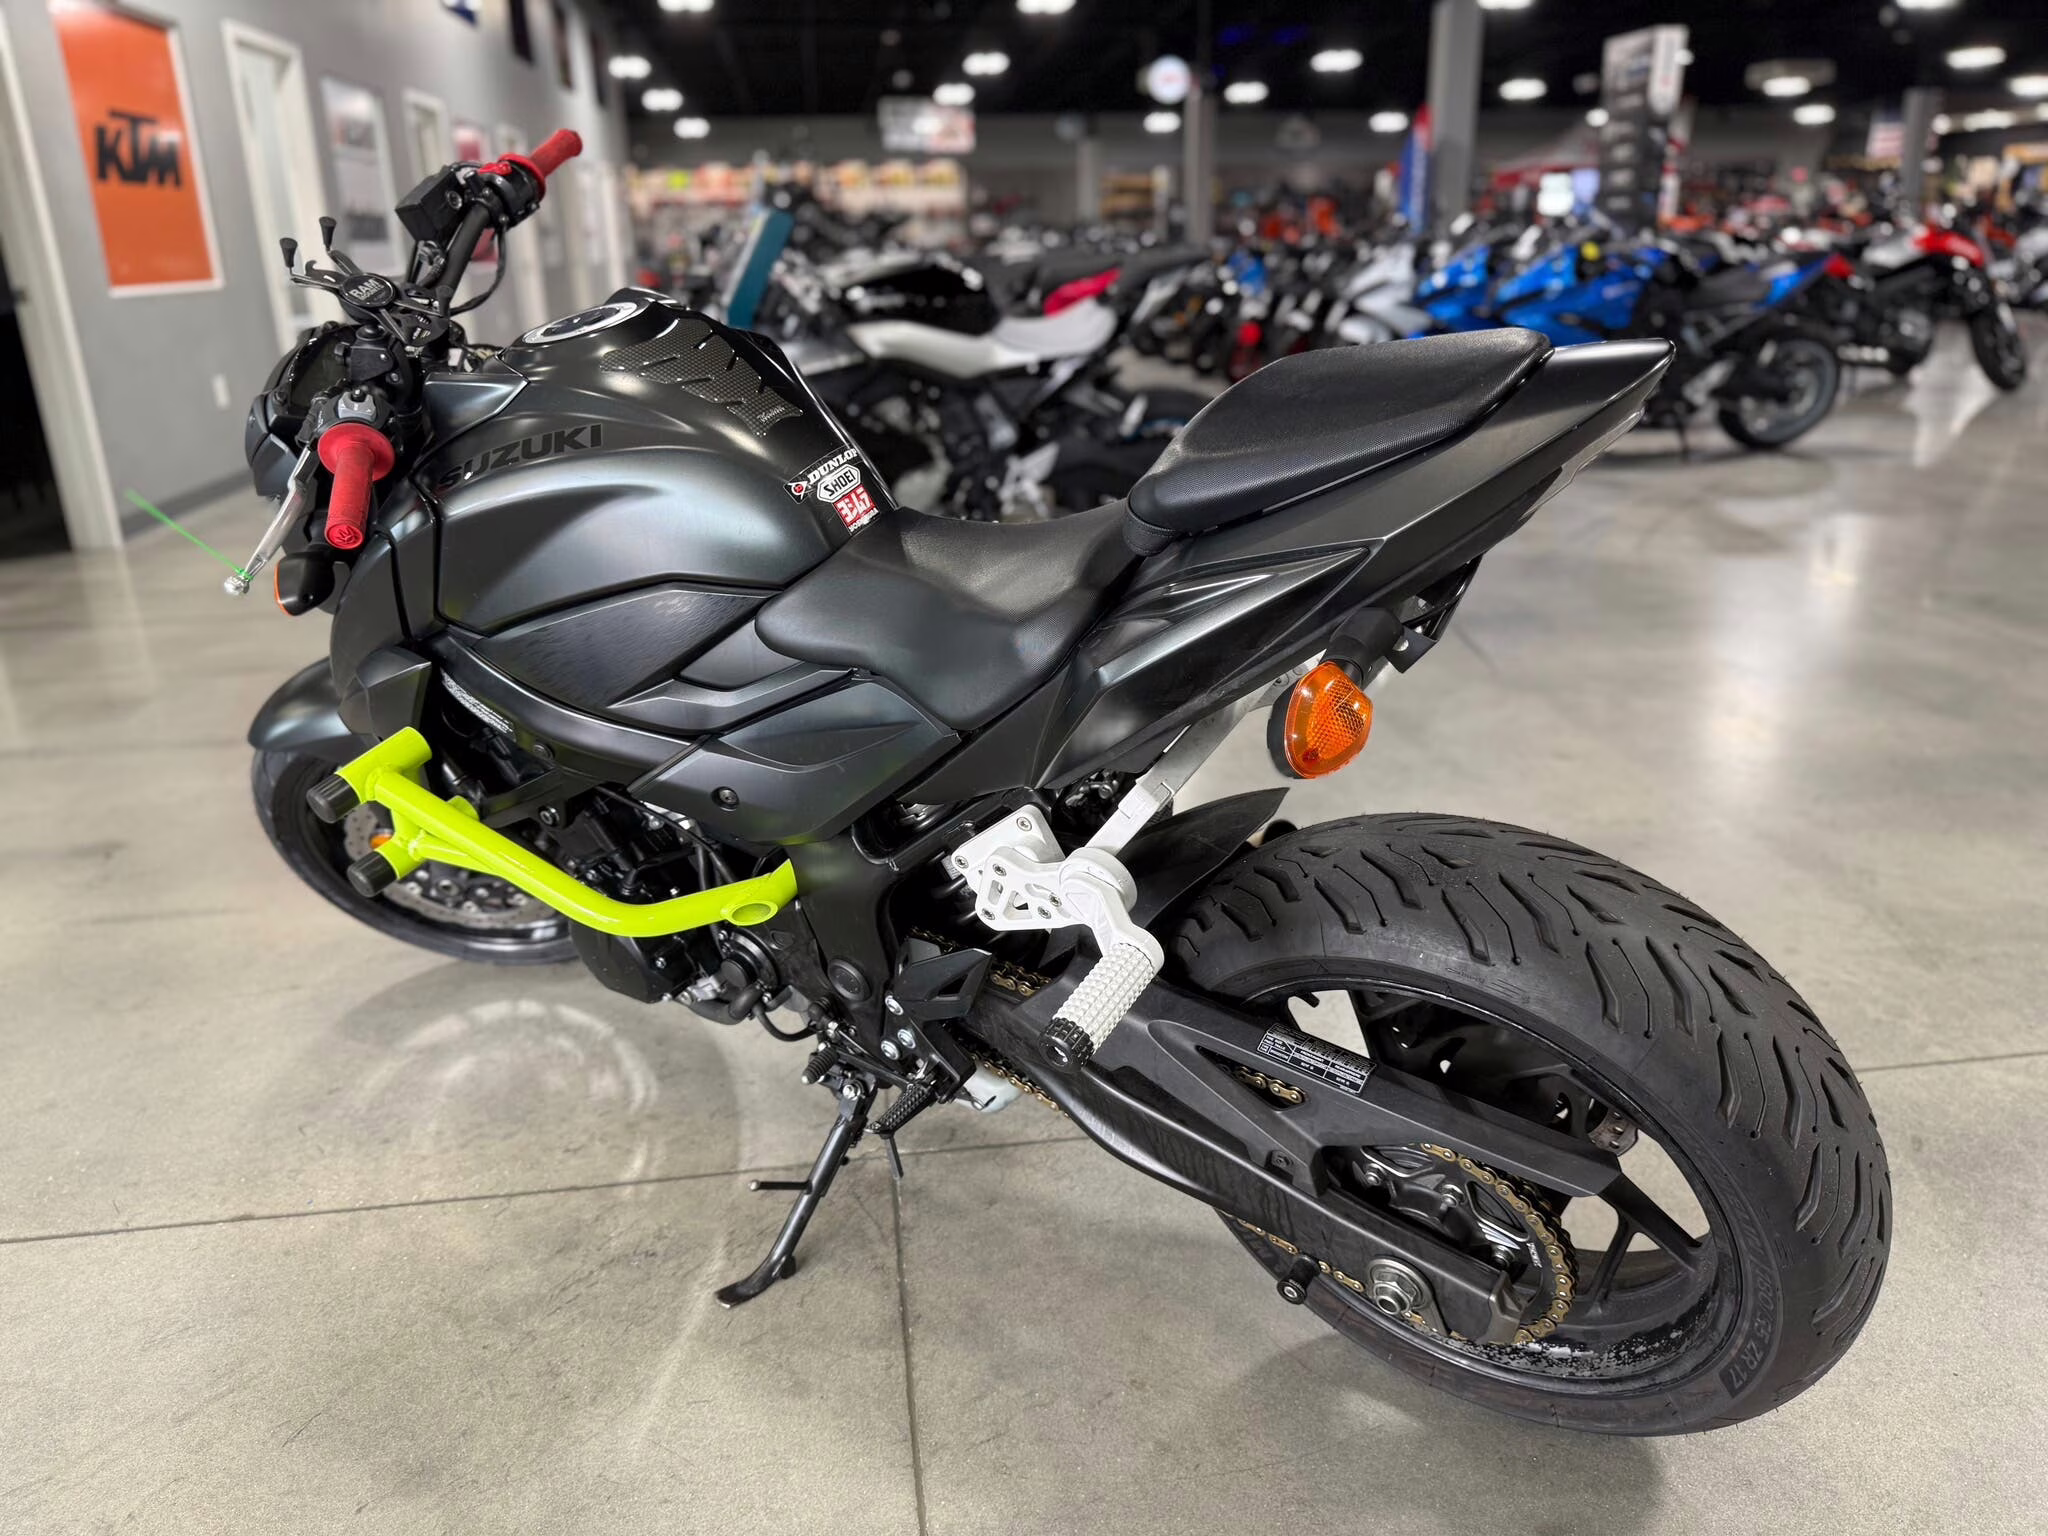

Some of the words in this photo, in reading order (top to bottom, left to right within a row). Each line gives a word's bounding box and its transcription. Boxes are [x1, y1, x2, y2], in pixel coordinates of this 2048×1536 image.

[95, 108, 182, 187] KTM
[349, 279, 380, 298] RAM
[439, 424, 602, 488] SUZUKI
[807, 448, 858, 485] DUNLOP
[823, 469, 856, 497] SHOEI
[1754, 1266, 1775, 1344] 180/55
[1740, 1341, 1763, 1371] ZR
[1729, 1364, 1749, 1390] 17
